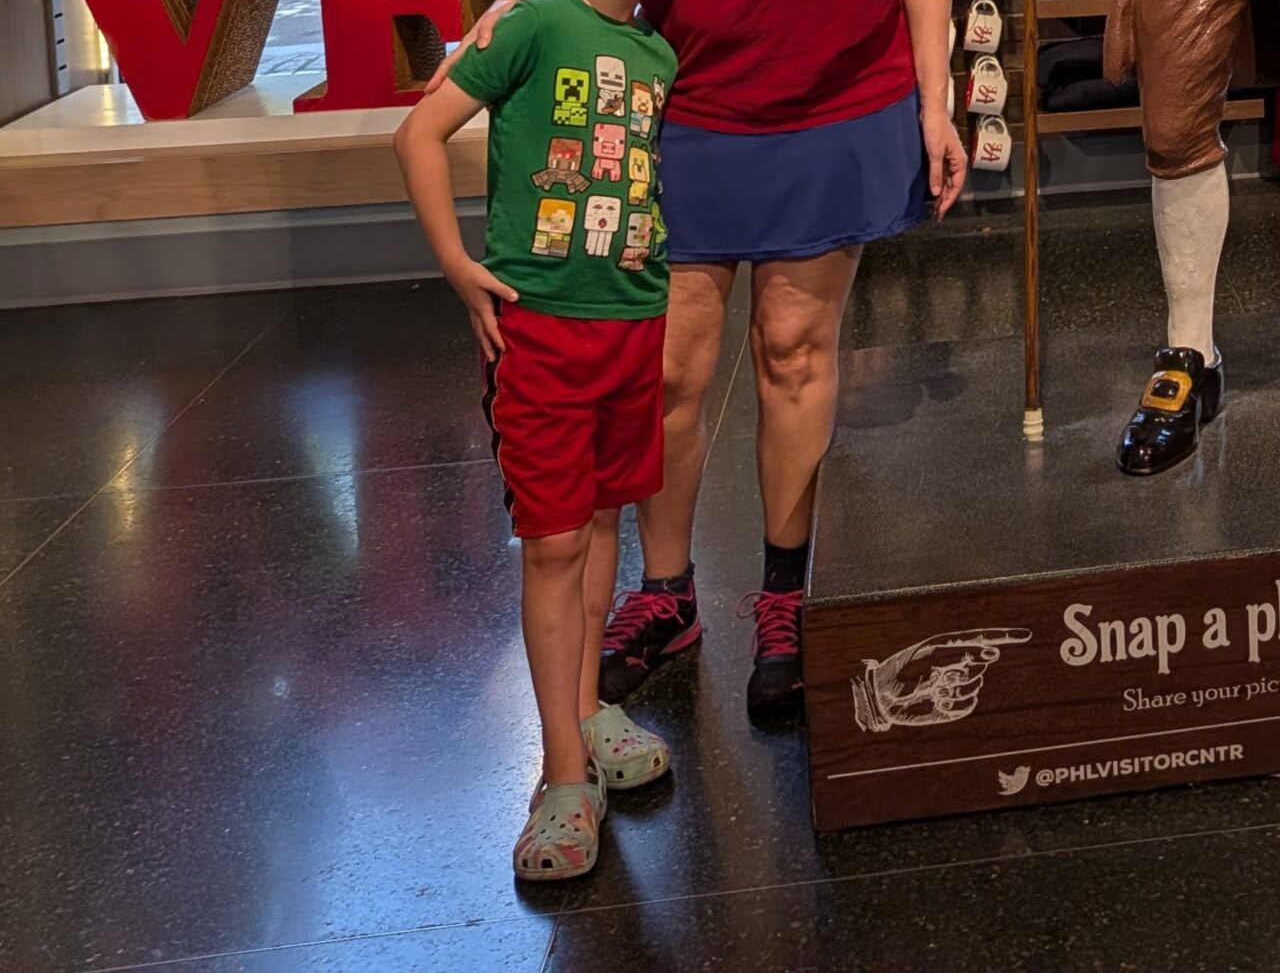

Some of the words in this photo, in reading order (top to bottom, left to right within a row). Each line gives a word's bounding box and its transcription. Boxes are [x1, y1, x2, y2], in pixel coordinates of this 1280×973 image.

[1059, 603, 1187, 675] Snap
[1202, 607, 1231, 649] a
[1122, 688, 1187, 711] Share
[1191, 683, 1241, 708] your
[1034, 743, 1245, 787] @PHLVISITORCNTR
